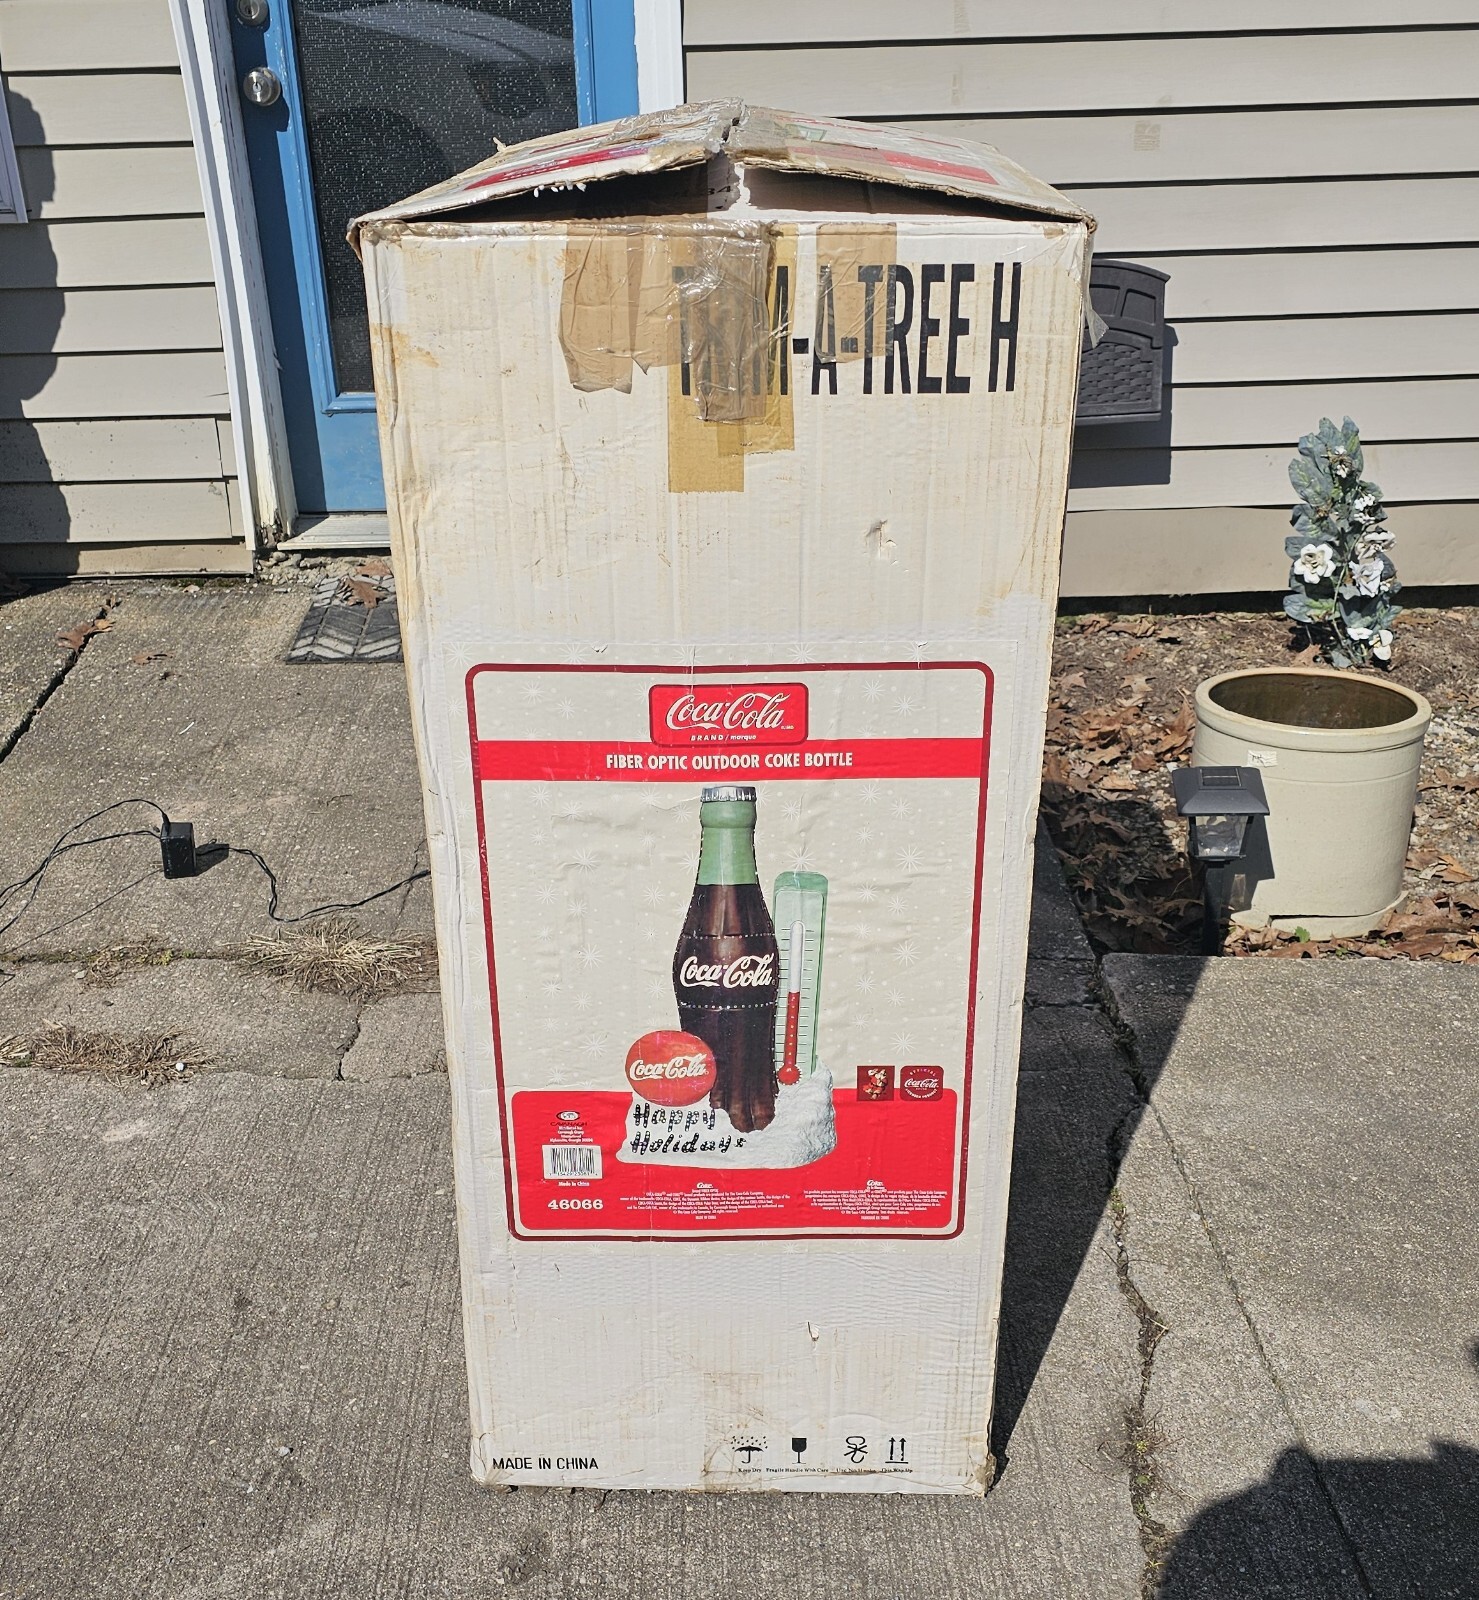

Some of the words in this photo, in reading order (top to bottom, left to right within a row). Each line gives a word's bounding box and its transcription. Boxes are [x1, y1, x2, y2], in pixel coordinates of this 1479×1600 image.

[988, 262, 1022, 393] H
[665, 692, 791, 730] Coca-Cola
[690, 734, 724, 742] BRAND
[606, 754, 643, 769] FIBER
[647, 755, 688, 770] OPTIC
[691, 754, 760, 770] OUTDOOR
[764, 753, 800, 768] COKE
[804, 752, 853, 767] BOTTLE
[680, 953, 775, 989] Coca-Cola
[629, 1053, 708, 1081] Coca-Cola
[904, 1078, 939, 1089] Coca-Cola
[633, 1103, 716, 1132] Happy
[629, 1131, 746, 1155] Holidays
[547, 1199, 604, 1210] 46066
[492, 1457, 533, 1470] MADE
[538, 1457, 552, 1470] IN
[556, 1457, 599, 1470] CHINA
